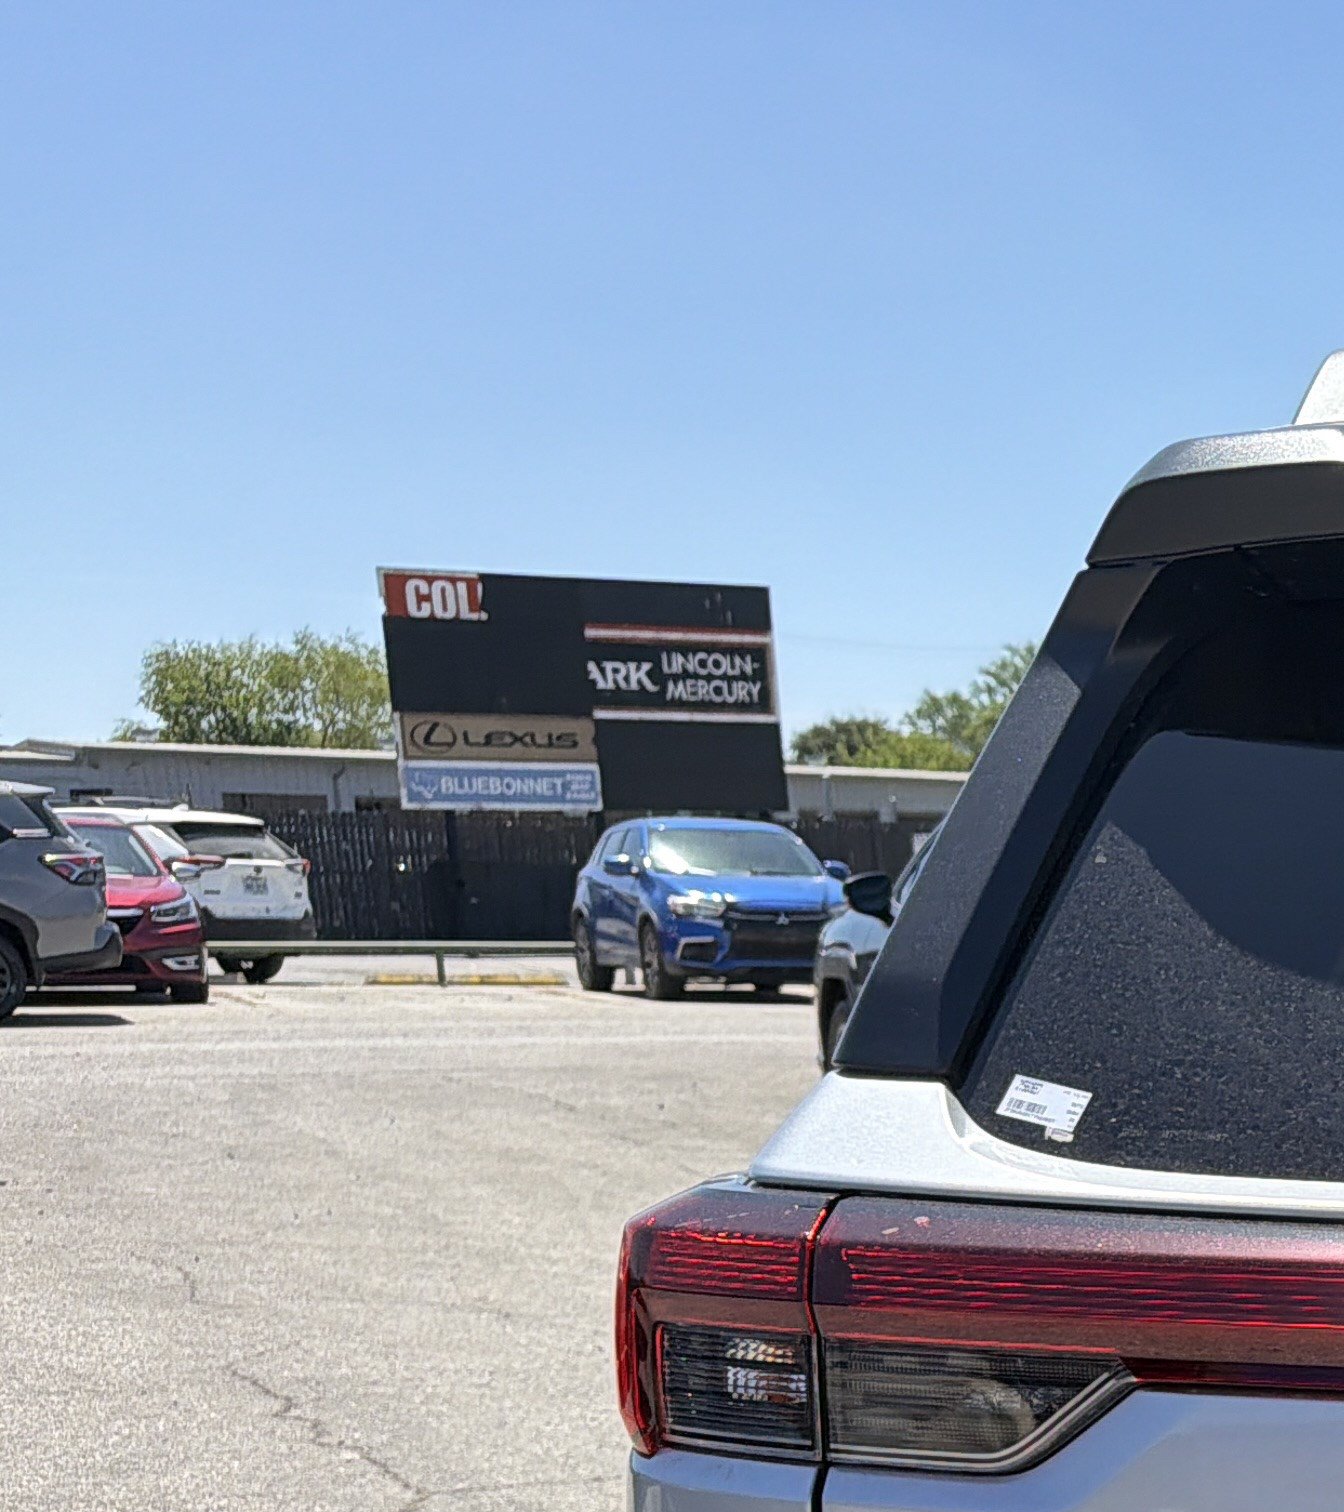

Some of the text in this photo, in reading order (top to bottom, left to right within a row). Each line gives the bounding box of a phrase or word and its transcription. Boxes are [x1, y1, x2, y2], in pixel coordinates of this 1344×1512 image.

[665, 678, 762, 704] MERCURY
[462, 730, 579, 749] LEXUS
[440, 775, 563, 796] BLUEBONNET
